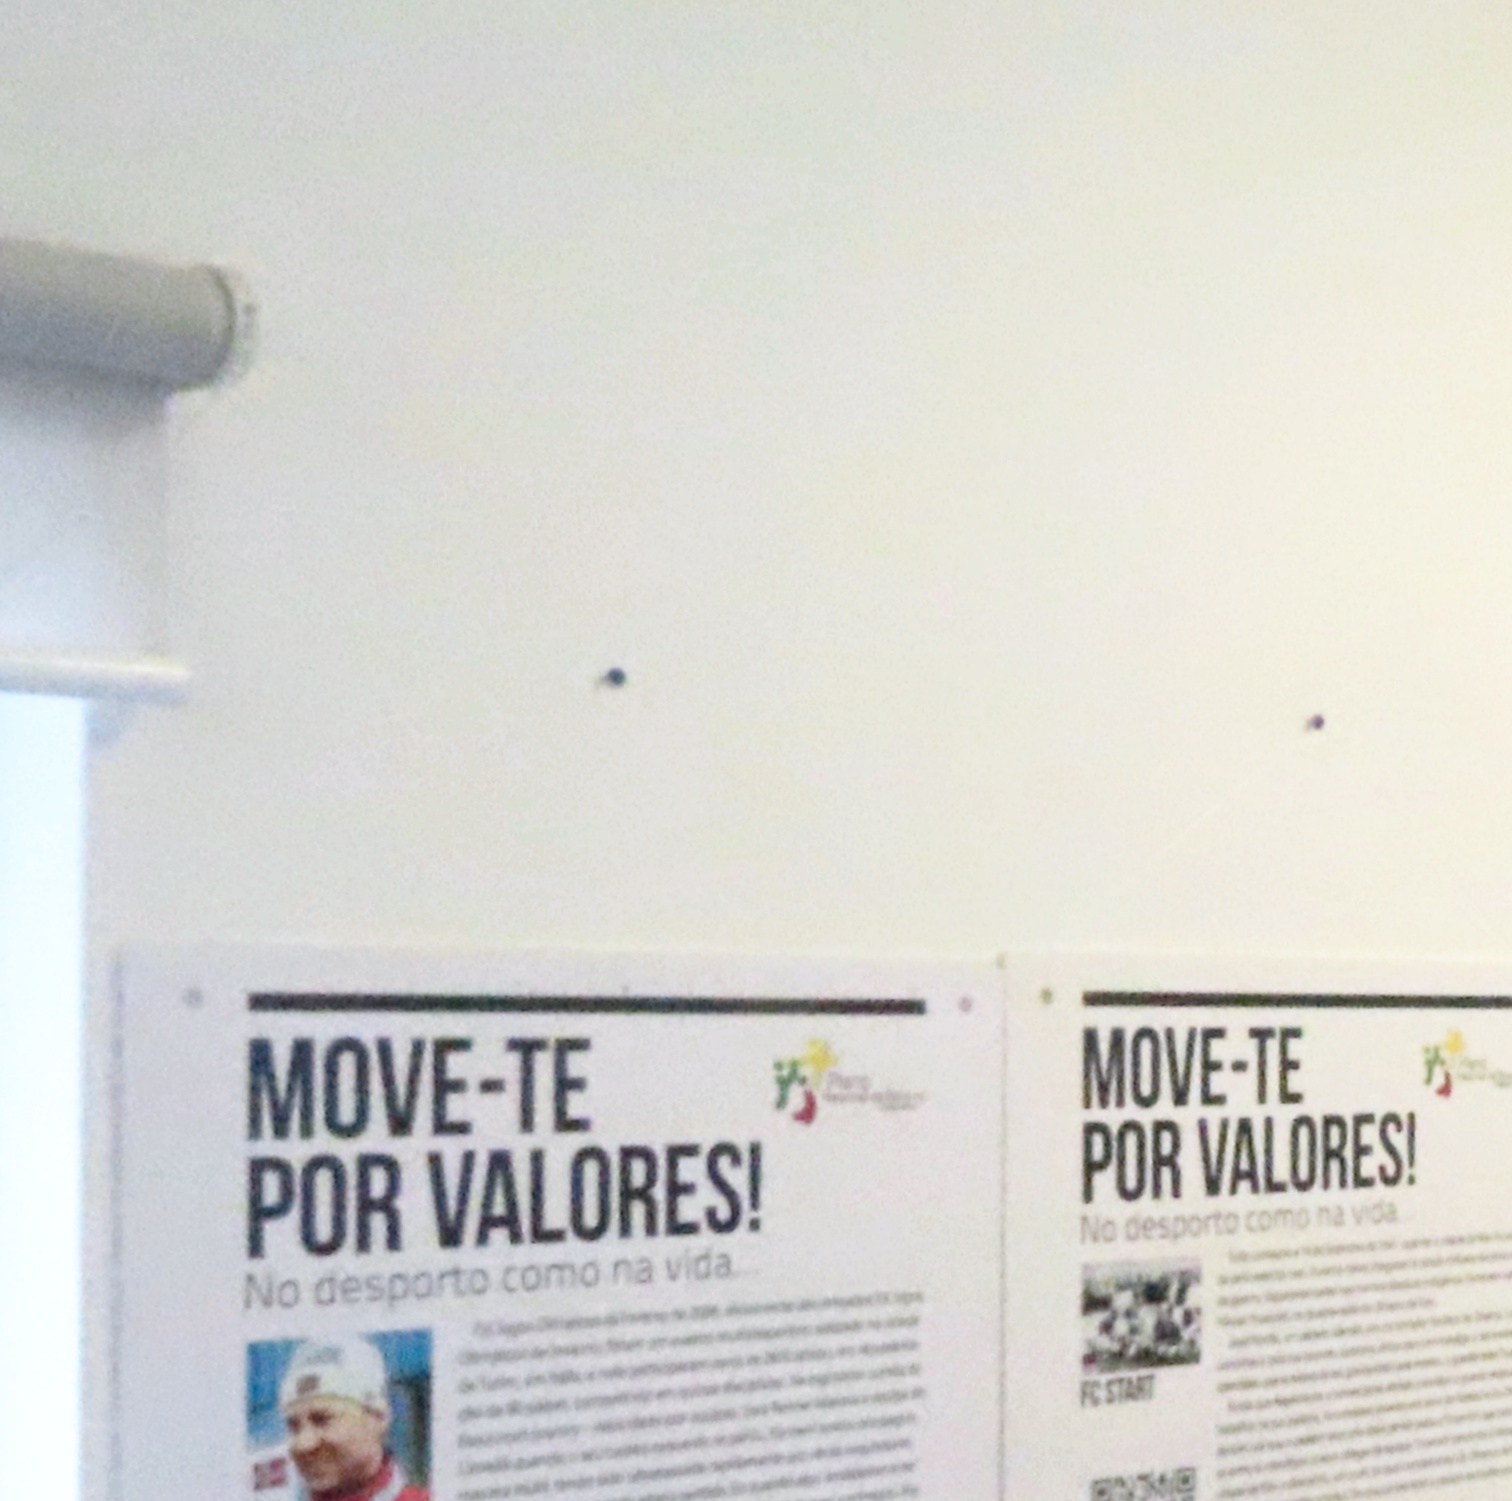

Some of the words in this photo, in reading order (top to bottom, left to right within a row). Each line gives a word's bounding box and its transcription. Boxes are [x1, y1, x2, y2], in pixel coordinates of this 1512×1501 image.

[247, 1037, 592, 1141] MOVE-TE
[1082, 1026, 1304, 1109] MOVE-TE
[247, 1153, 402, 1258] POR
[428, 1142, 763, 1249] VALORES!
[1081, 1119, 1182, 1204] POR
[1199, 1112, 1417, 1198] VALORES!
[1080, 1214, 1116, 1244] No
[1125, 1211, 1238, 1243] desporto
[1245, 1207, 1310, 1233] como
[1317, 1206, 1344, 1227] na
[243, 1273, 299, 1310] No
[314, 1262, 488, 1308] desporto
[502, 1256, 600, 1294] como
[612, 1256, 653, 1284] na
